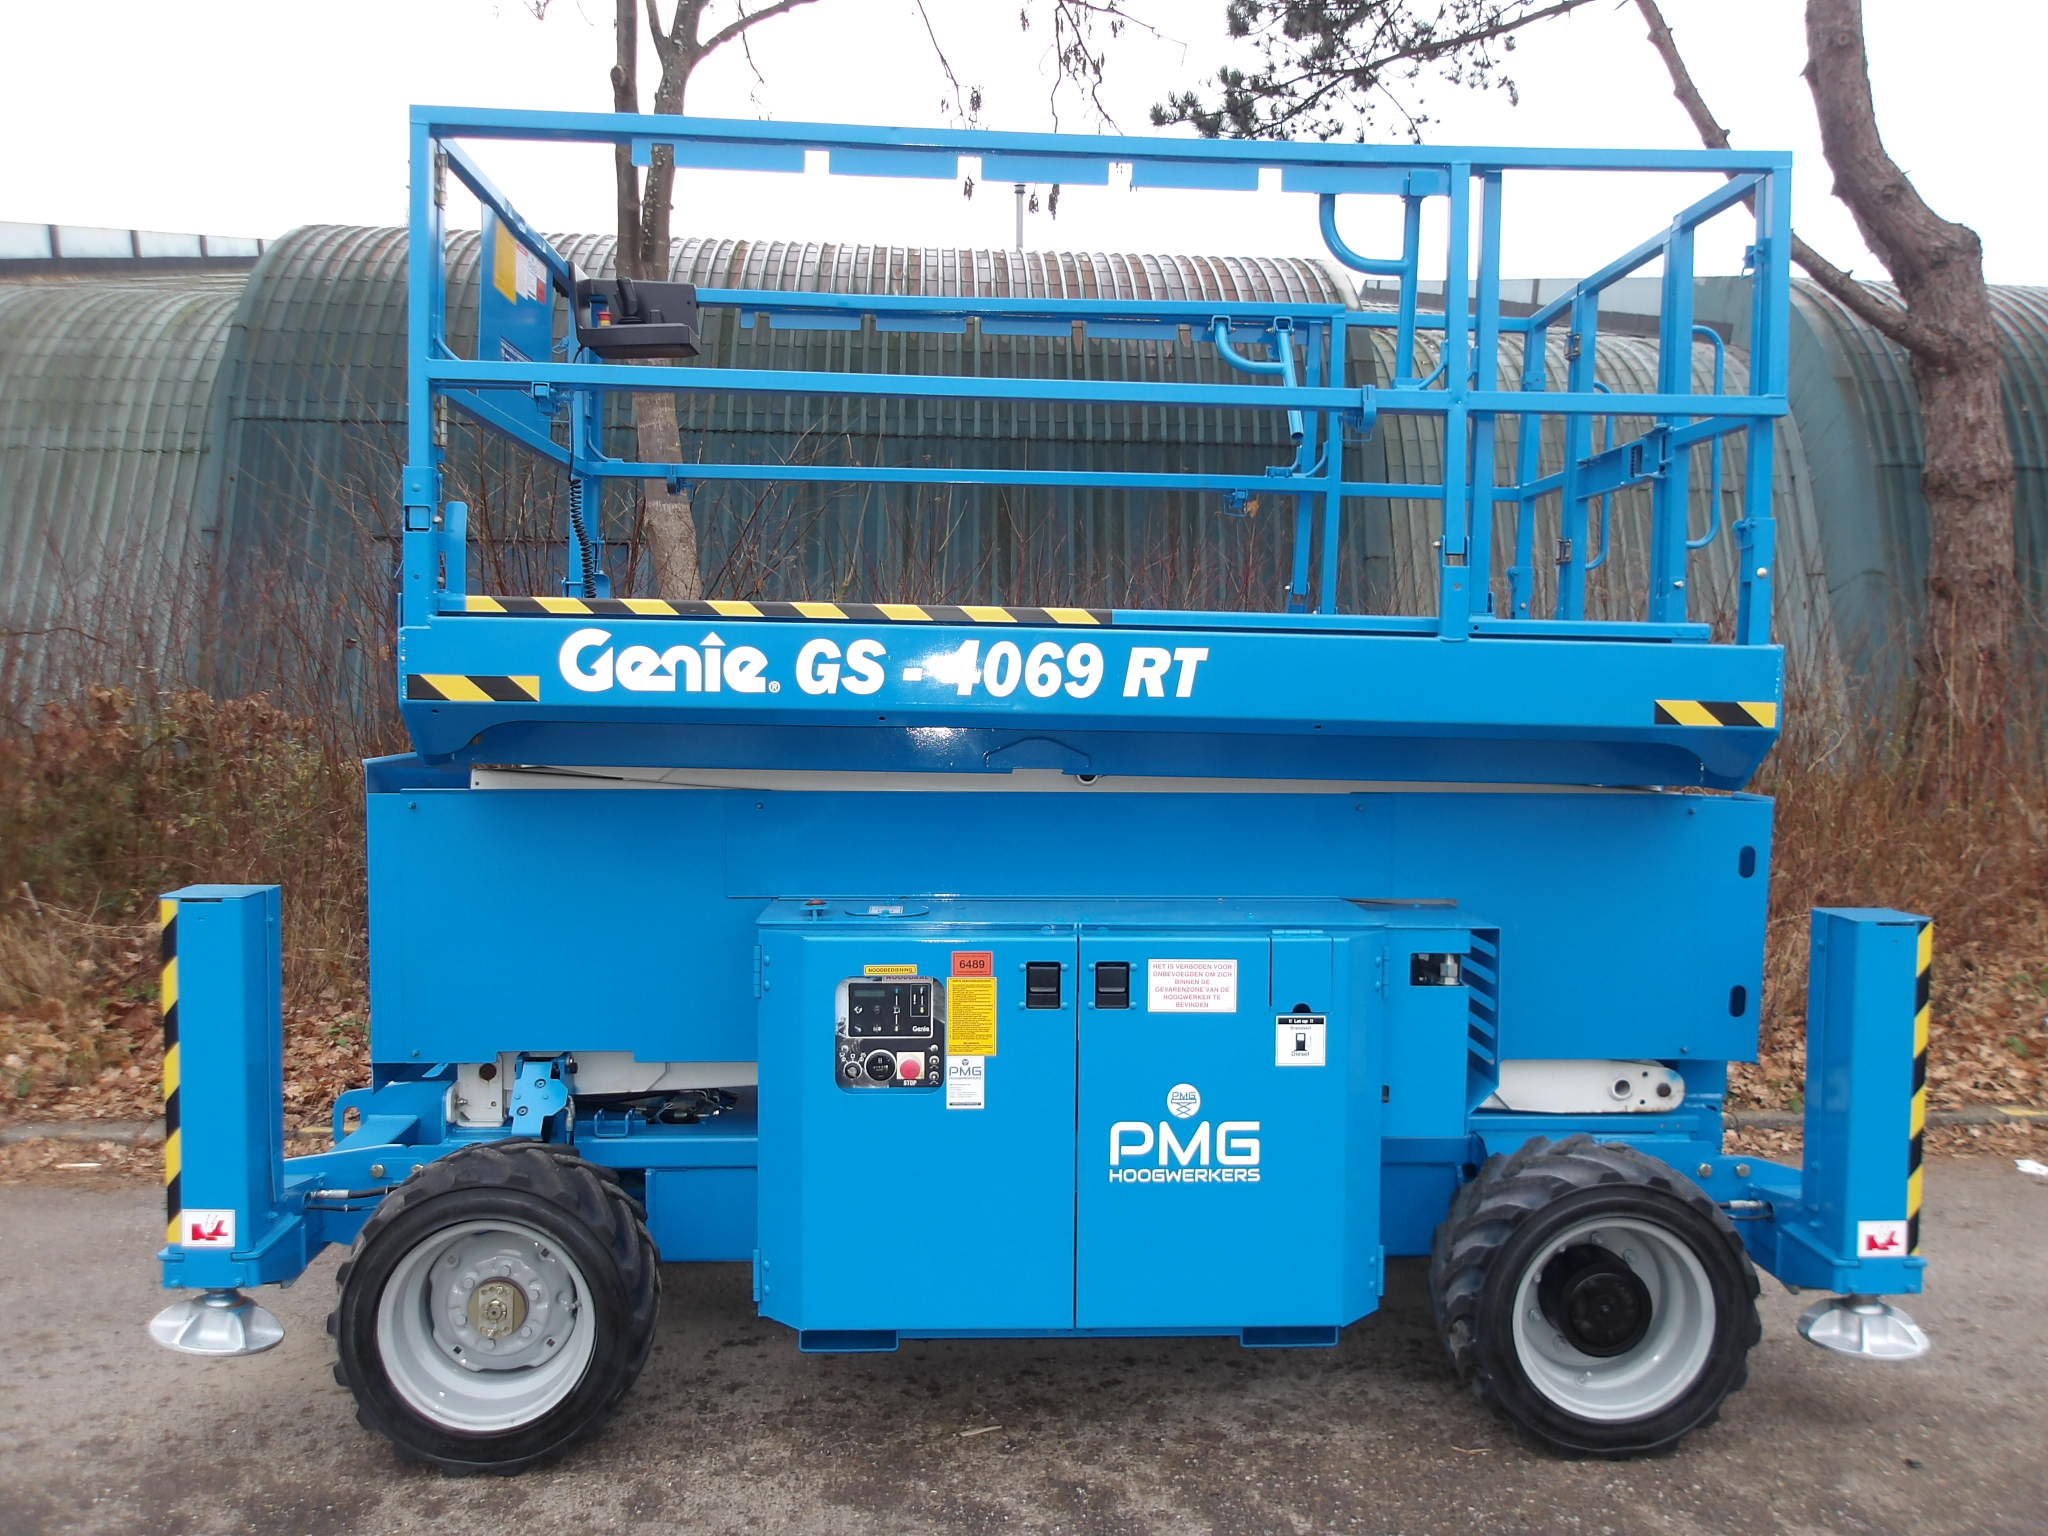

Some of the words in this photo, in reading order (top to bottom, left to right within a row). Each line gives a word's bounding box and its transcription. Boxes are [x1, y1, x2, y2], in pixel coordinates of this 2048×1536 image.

[796, 638, 886, 695] GS
[902, 667, 922, 682] -
[938, 640, 1104, 698] 4069
[1123, 647, 1209, 698] RT
[959, 959, 985, 969] 6489
[912, 1025, 930, 1033] Genie
[949, 1066, 982, 1076] PMG
[1172, 1091, 1196, 1100] PMG
[1110, 1120, 1260, 1166] PMG
[1109, 1168, 1261, 1183] HOOGWERKERS
